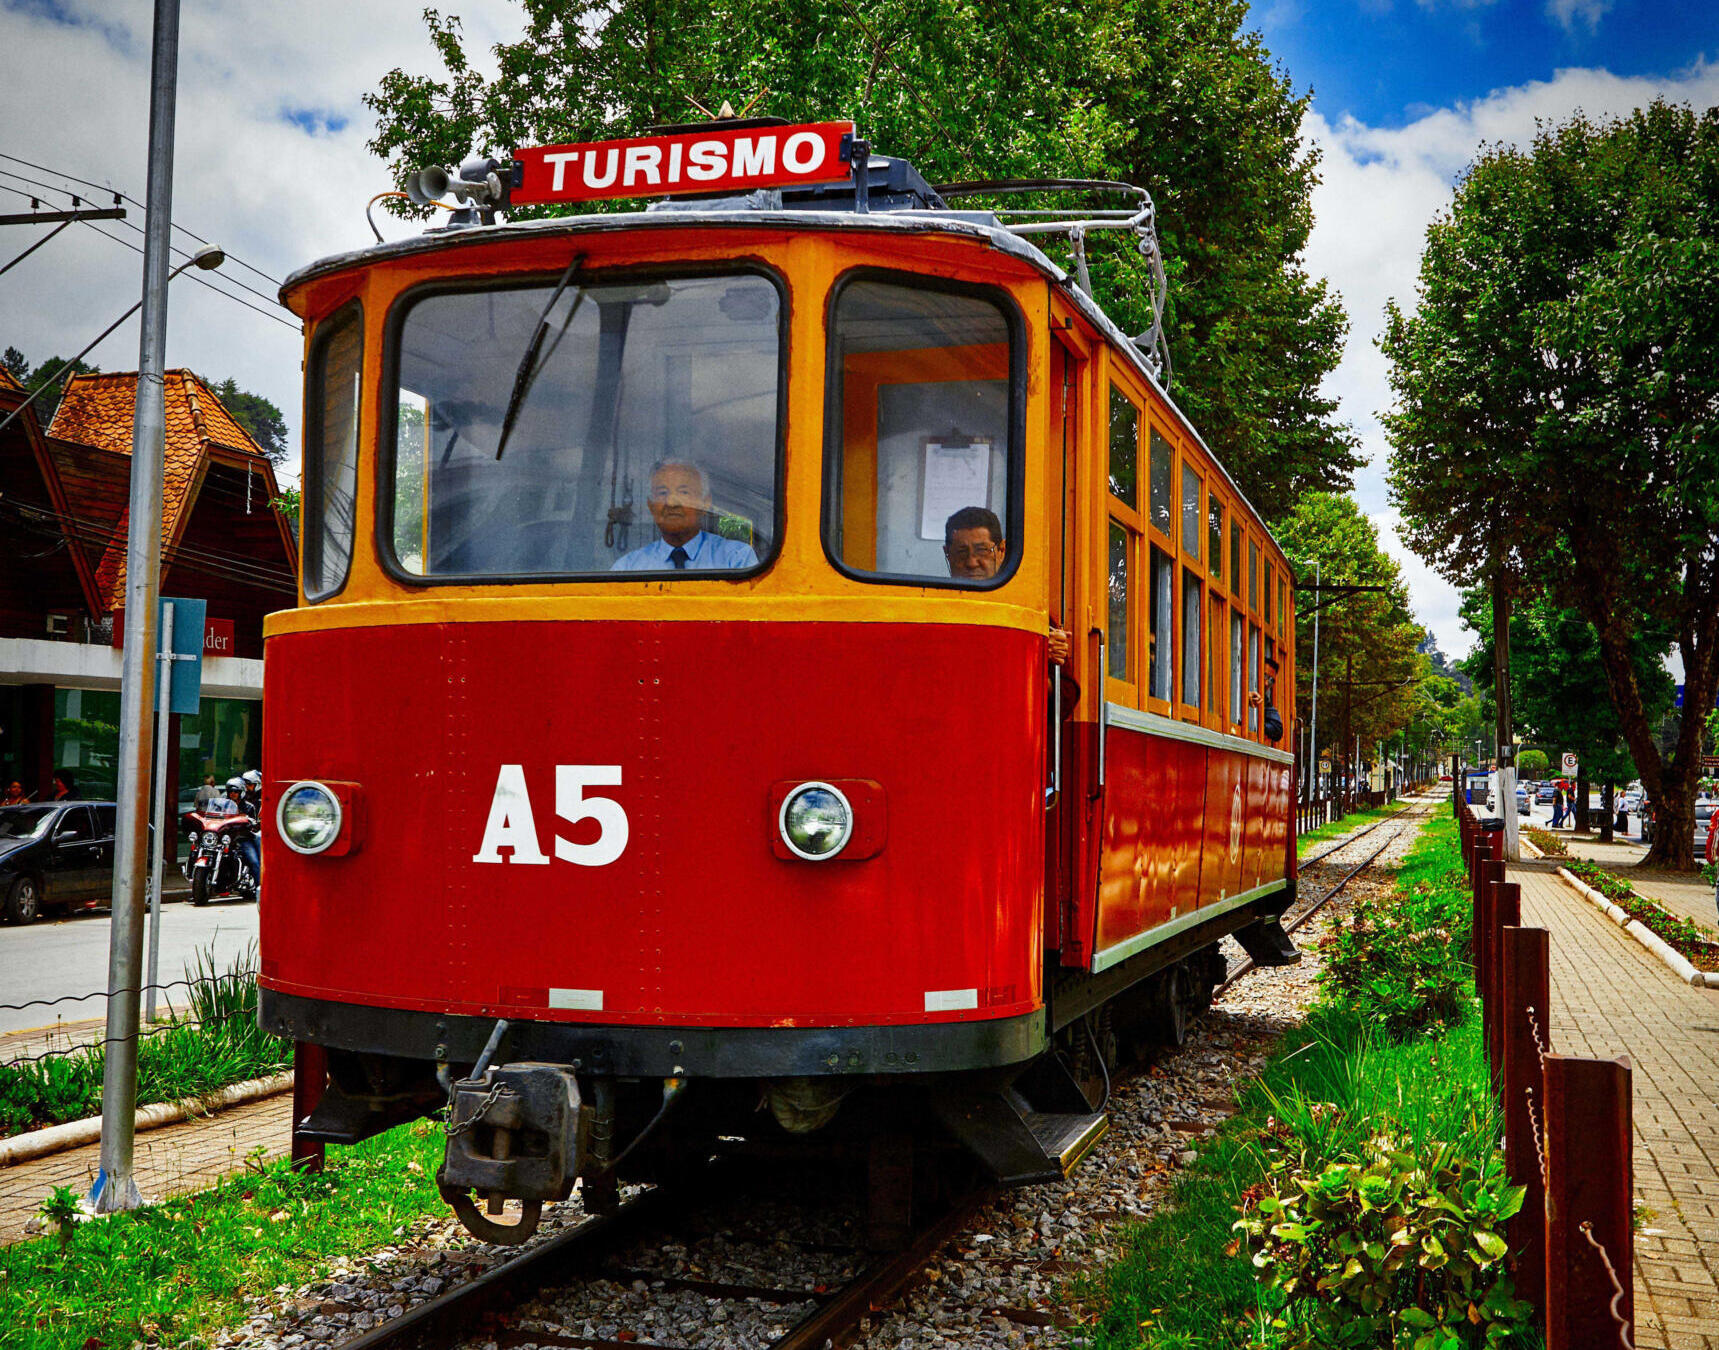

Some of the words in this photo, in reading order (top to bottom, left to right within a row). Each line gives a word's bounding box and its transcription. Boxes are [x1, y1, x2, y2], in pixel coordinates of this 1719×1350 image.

[543, 132, 826, 191] TURISMO
[203, 626, 228, 650] der
[472, 764, 629, 867] A5
